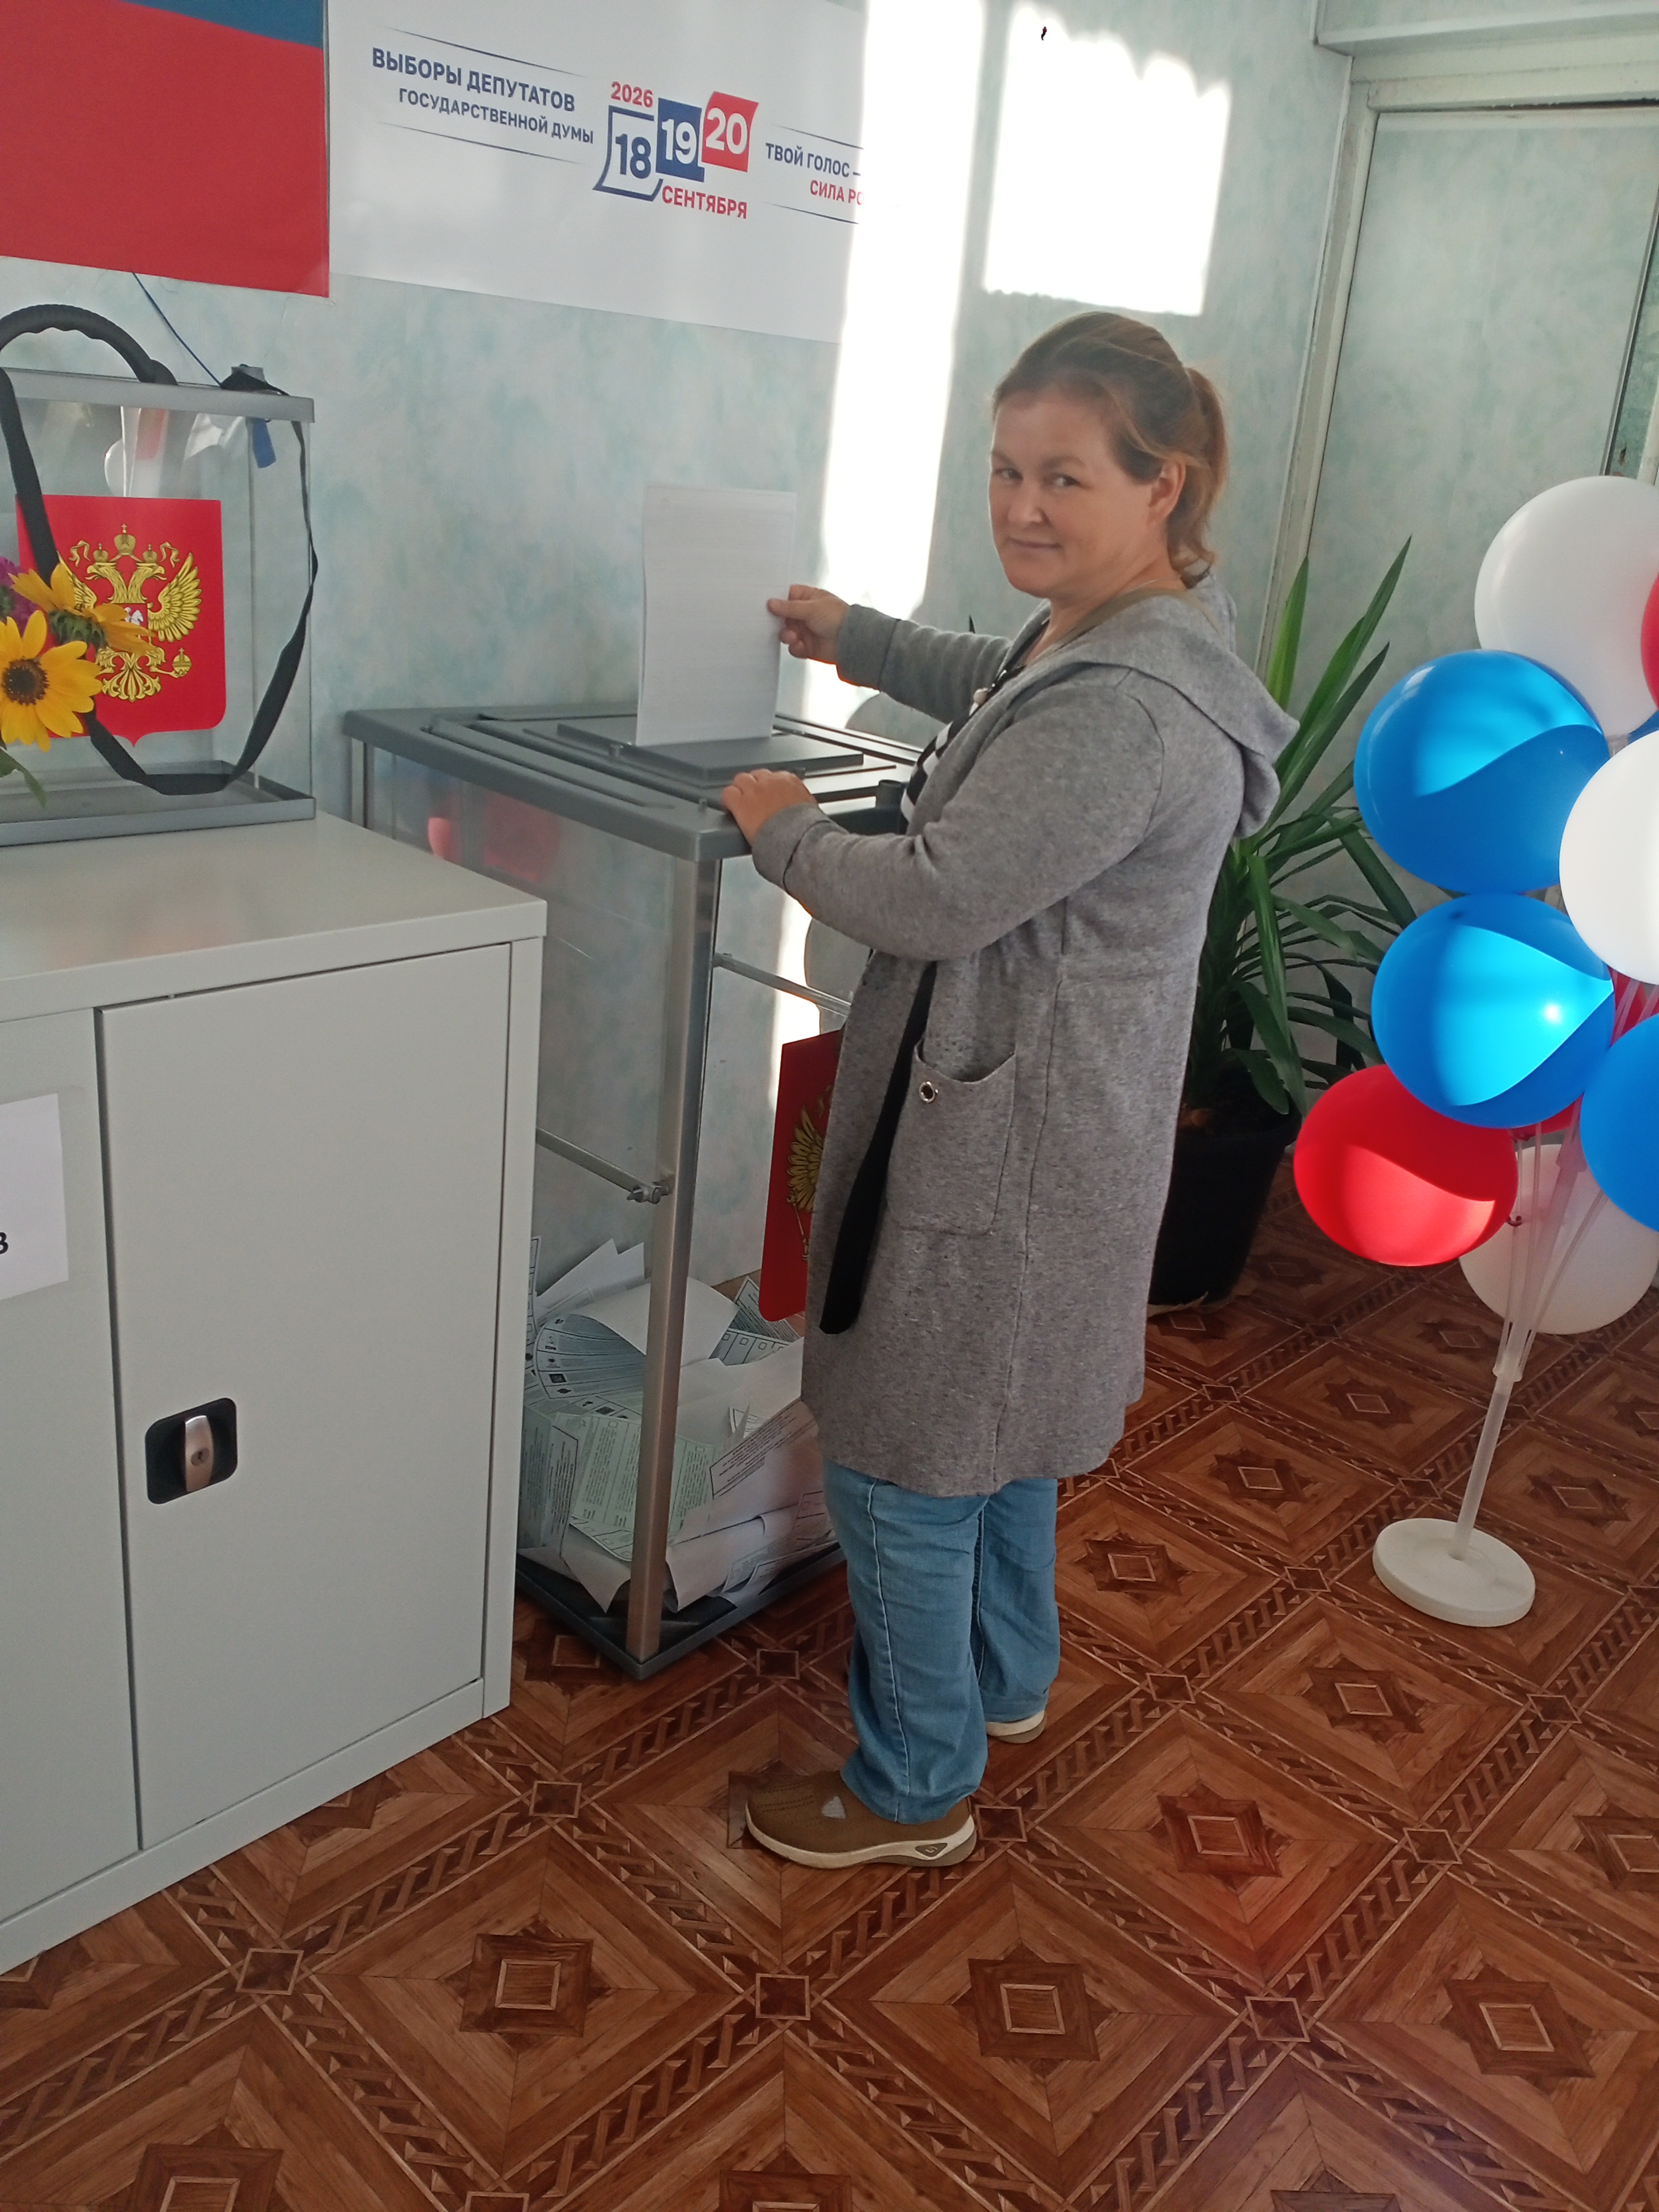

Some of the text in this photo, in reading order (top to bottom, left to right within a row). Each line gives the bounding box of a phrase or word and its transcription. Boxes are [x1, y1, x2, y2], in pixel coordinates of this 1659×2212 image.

[372, 47, 575, 111] ВЫБОРЫ ДЕПУТАТОВ
[611, 81, 653, 107] 2026
[399, 88, 593, 144] ГОСУДАРСТВЕННОЙ ДУМЫ
[615, 107, 748, 179] 18 19 20
[765, 143, 803, 166] ТВОЙ
[807, 153, 850, 178] ГОЛОС
[662, 185, 748, 219] СЕНТЯБРЯ
[810, 180, 844, 202] СИЛА
